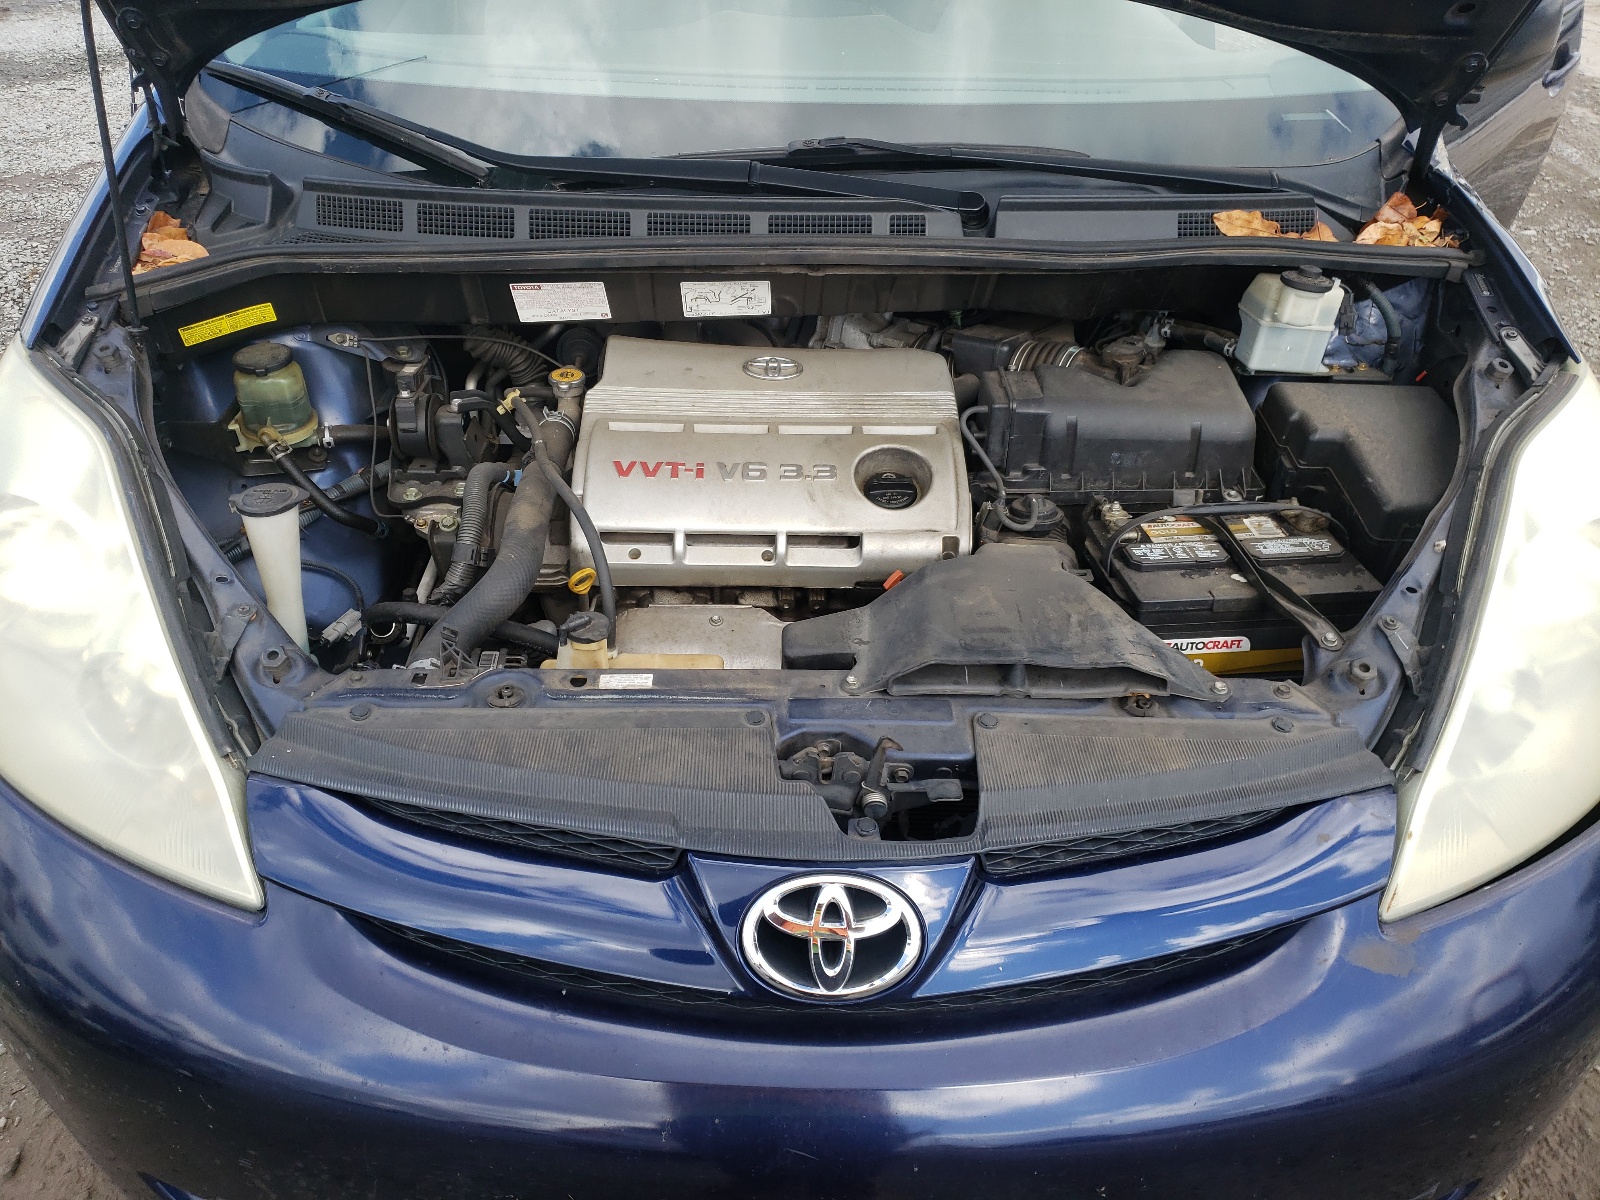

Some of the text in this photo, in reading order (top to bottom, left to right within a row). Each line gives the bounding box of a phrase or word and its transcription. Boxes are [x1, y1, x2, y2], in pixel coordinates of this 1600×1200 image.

[612, 460, 838, 482] VVT-i V6 3.3
[1172, 639, 1243, 651] AUTOCRAFT
